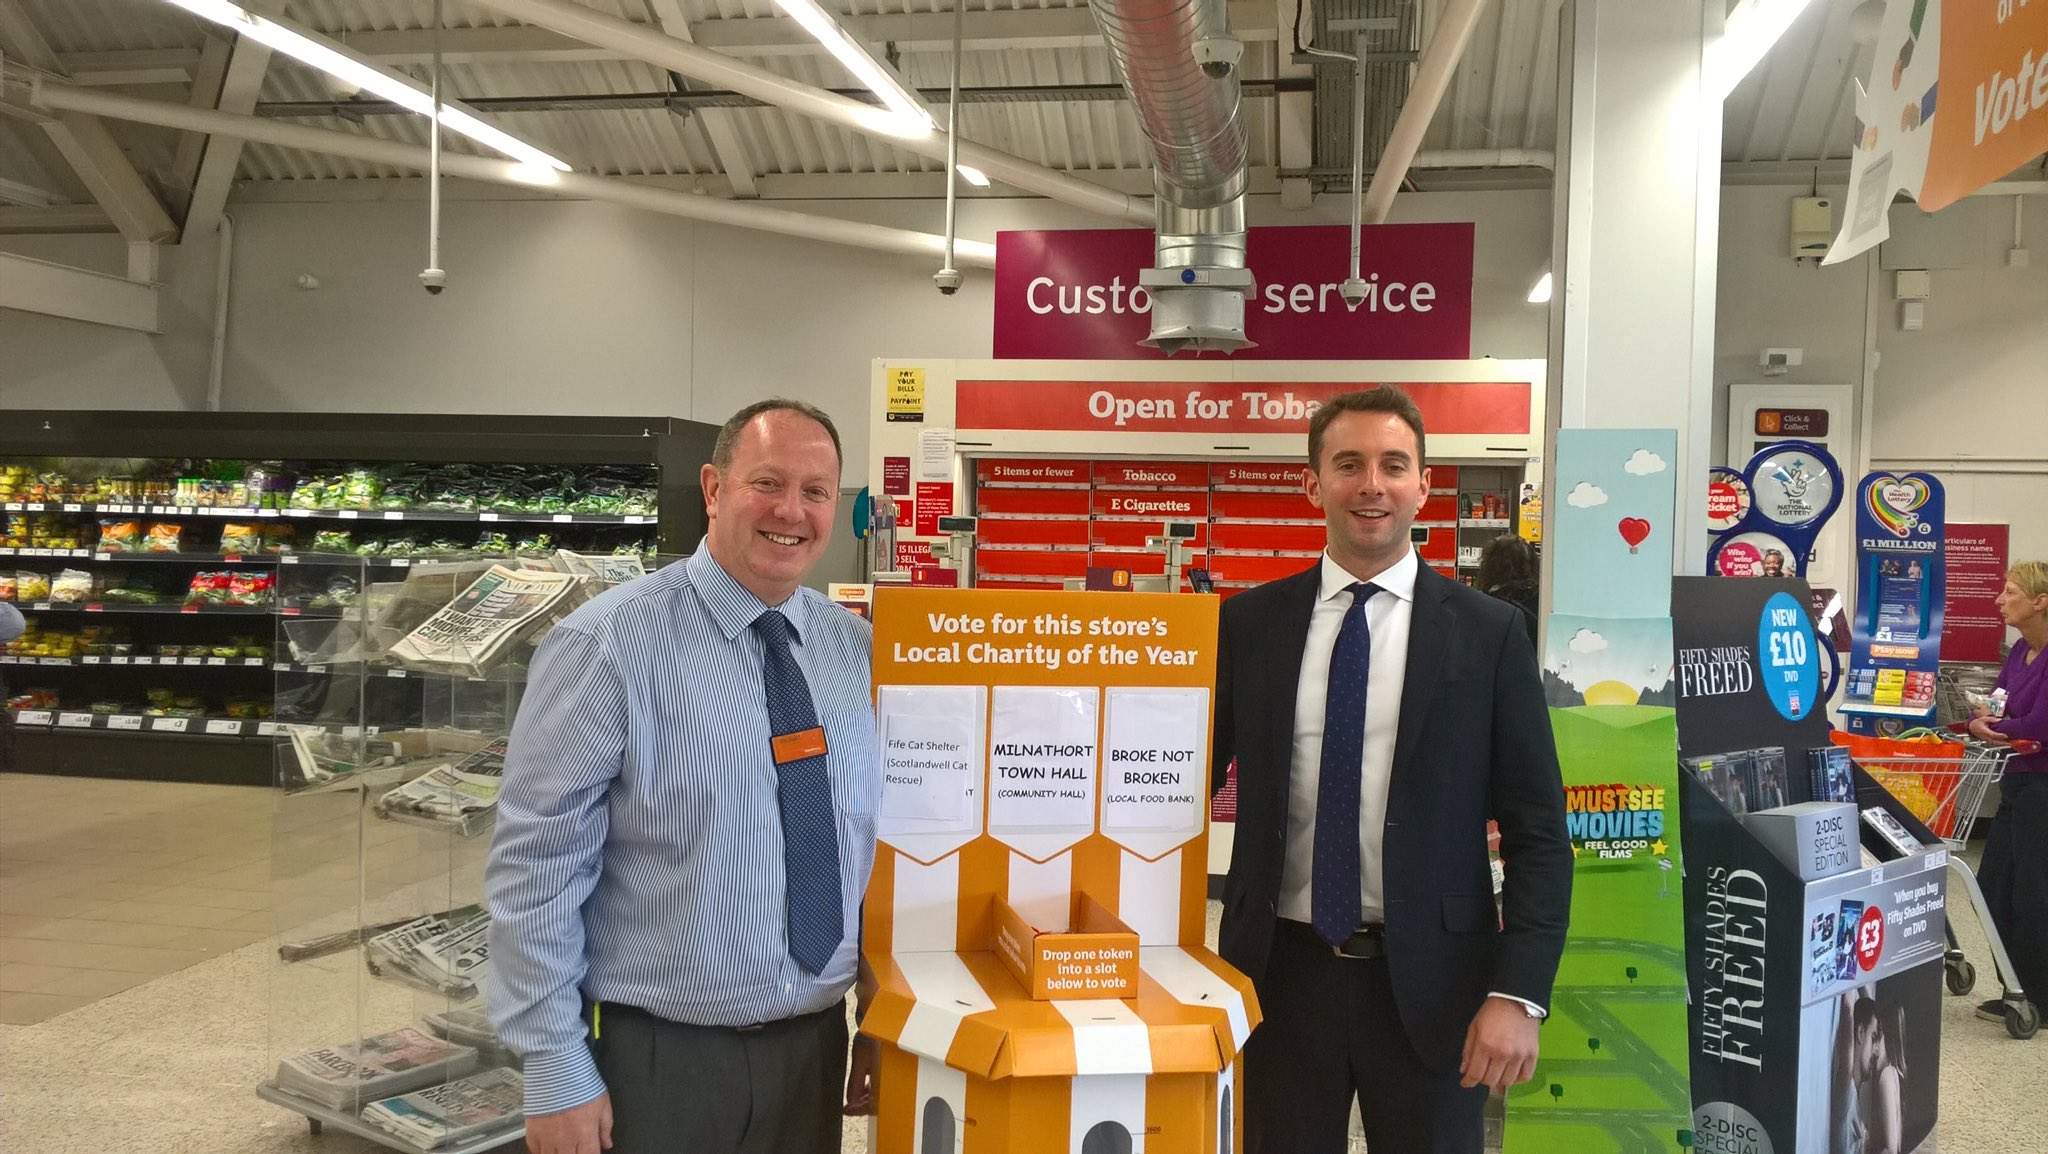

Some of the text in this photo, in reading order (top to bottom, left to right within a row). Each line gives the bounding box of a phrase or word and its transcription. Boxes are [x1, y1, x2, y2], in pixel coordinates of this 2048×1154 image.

[1026, 273, 1437, 315] Custo serice
[1088, 390, 1320, 425] Open for Toba
[1783, 423, 1809, 431] Collect
[994, 466, 1074, 478] 5 items or fewer
[1122, 469, 1177, 482] Tobacco
[1229, 469, 1304, 480] 5 items or few
[1111, 498, 1191, 512] E Cigarettes
[1708, 495, 1736, 503] ream
[1877, 539, 1937, 550] MILLION
[1978, 537, 1986, 545] of
[899, 545, 931, 553] IS ILLEGA
[1727, 548, 1746, 556] Who
[1970, 545, 1994, 553] names
[900, 555, 918, 563] SELL
[1733, 555, 1753, 563] wins
[1771, 608, 1797, 627] NEW
[928, 613, 1168, 637] Vote for this store's
[1769, 630, 1807, 667] £10
[894, 642, 1199, 671] Local Charity of the Year
[1679, 646, 1750, 665] FIFTY SHADES
[1679, 660, 1753, 698] FREED
[1783, 670, 1799, 683] DVD
[888, 740, 961, 752] Fife Cat Shelter
[994, 744, 1095, 758] MILNATHORT
[1111, 750, 1195, 763] BROKE NOT
[886, 758, 969, 771] (Scotlandwell Cat
[998, 766, 1088, 780] TOWN HALL
[1123, 772, 1181, 785] BROKEN
[885, 774, 923, 786] Rescue)
[998, 789, 1086, 799] (COMMUNITY HALL)
[1107, 795, 1195, 805] (LOCAL FOOD BANK)
[1566, 809, 1665, 840] MOVIES
[1815, 816, 1843, 835] 2-DISC
[1584, 840, 1648, 850] FEEL GOOD
[1814, 834, 1848, 854] SPECIAL
[1599, 849, 1633, 859] FILMS
[1815, 851, 1849, 872] EDITION
[1914, 886, 1927, 902] you
[1926, 881, 1939, 896] buy
[1887, 894, 1945, 926] Fifty Shades Freed
[1903, 919, 1927, 938] on DVD
[1042, 948, 1133, 962] Drop one token
[1702, 866, 1727, 1057] FIFTY SHADES
[1058, 963, 1117, 975] into a slot
[1720, 868, 1769, 1074] FREED
[1047, 977, 1127, 990] below to vote
[1702, 1114, 1758, 1143] 2-DISC
